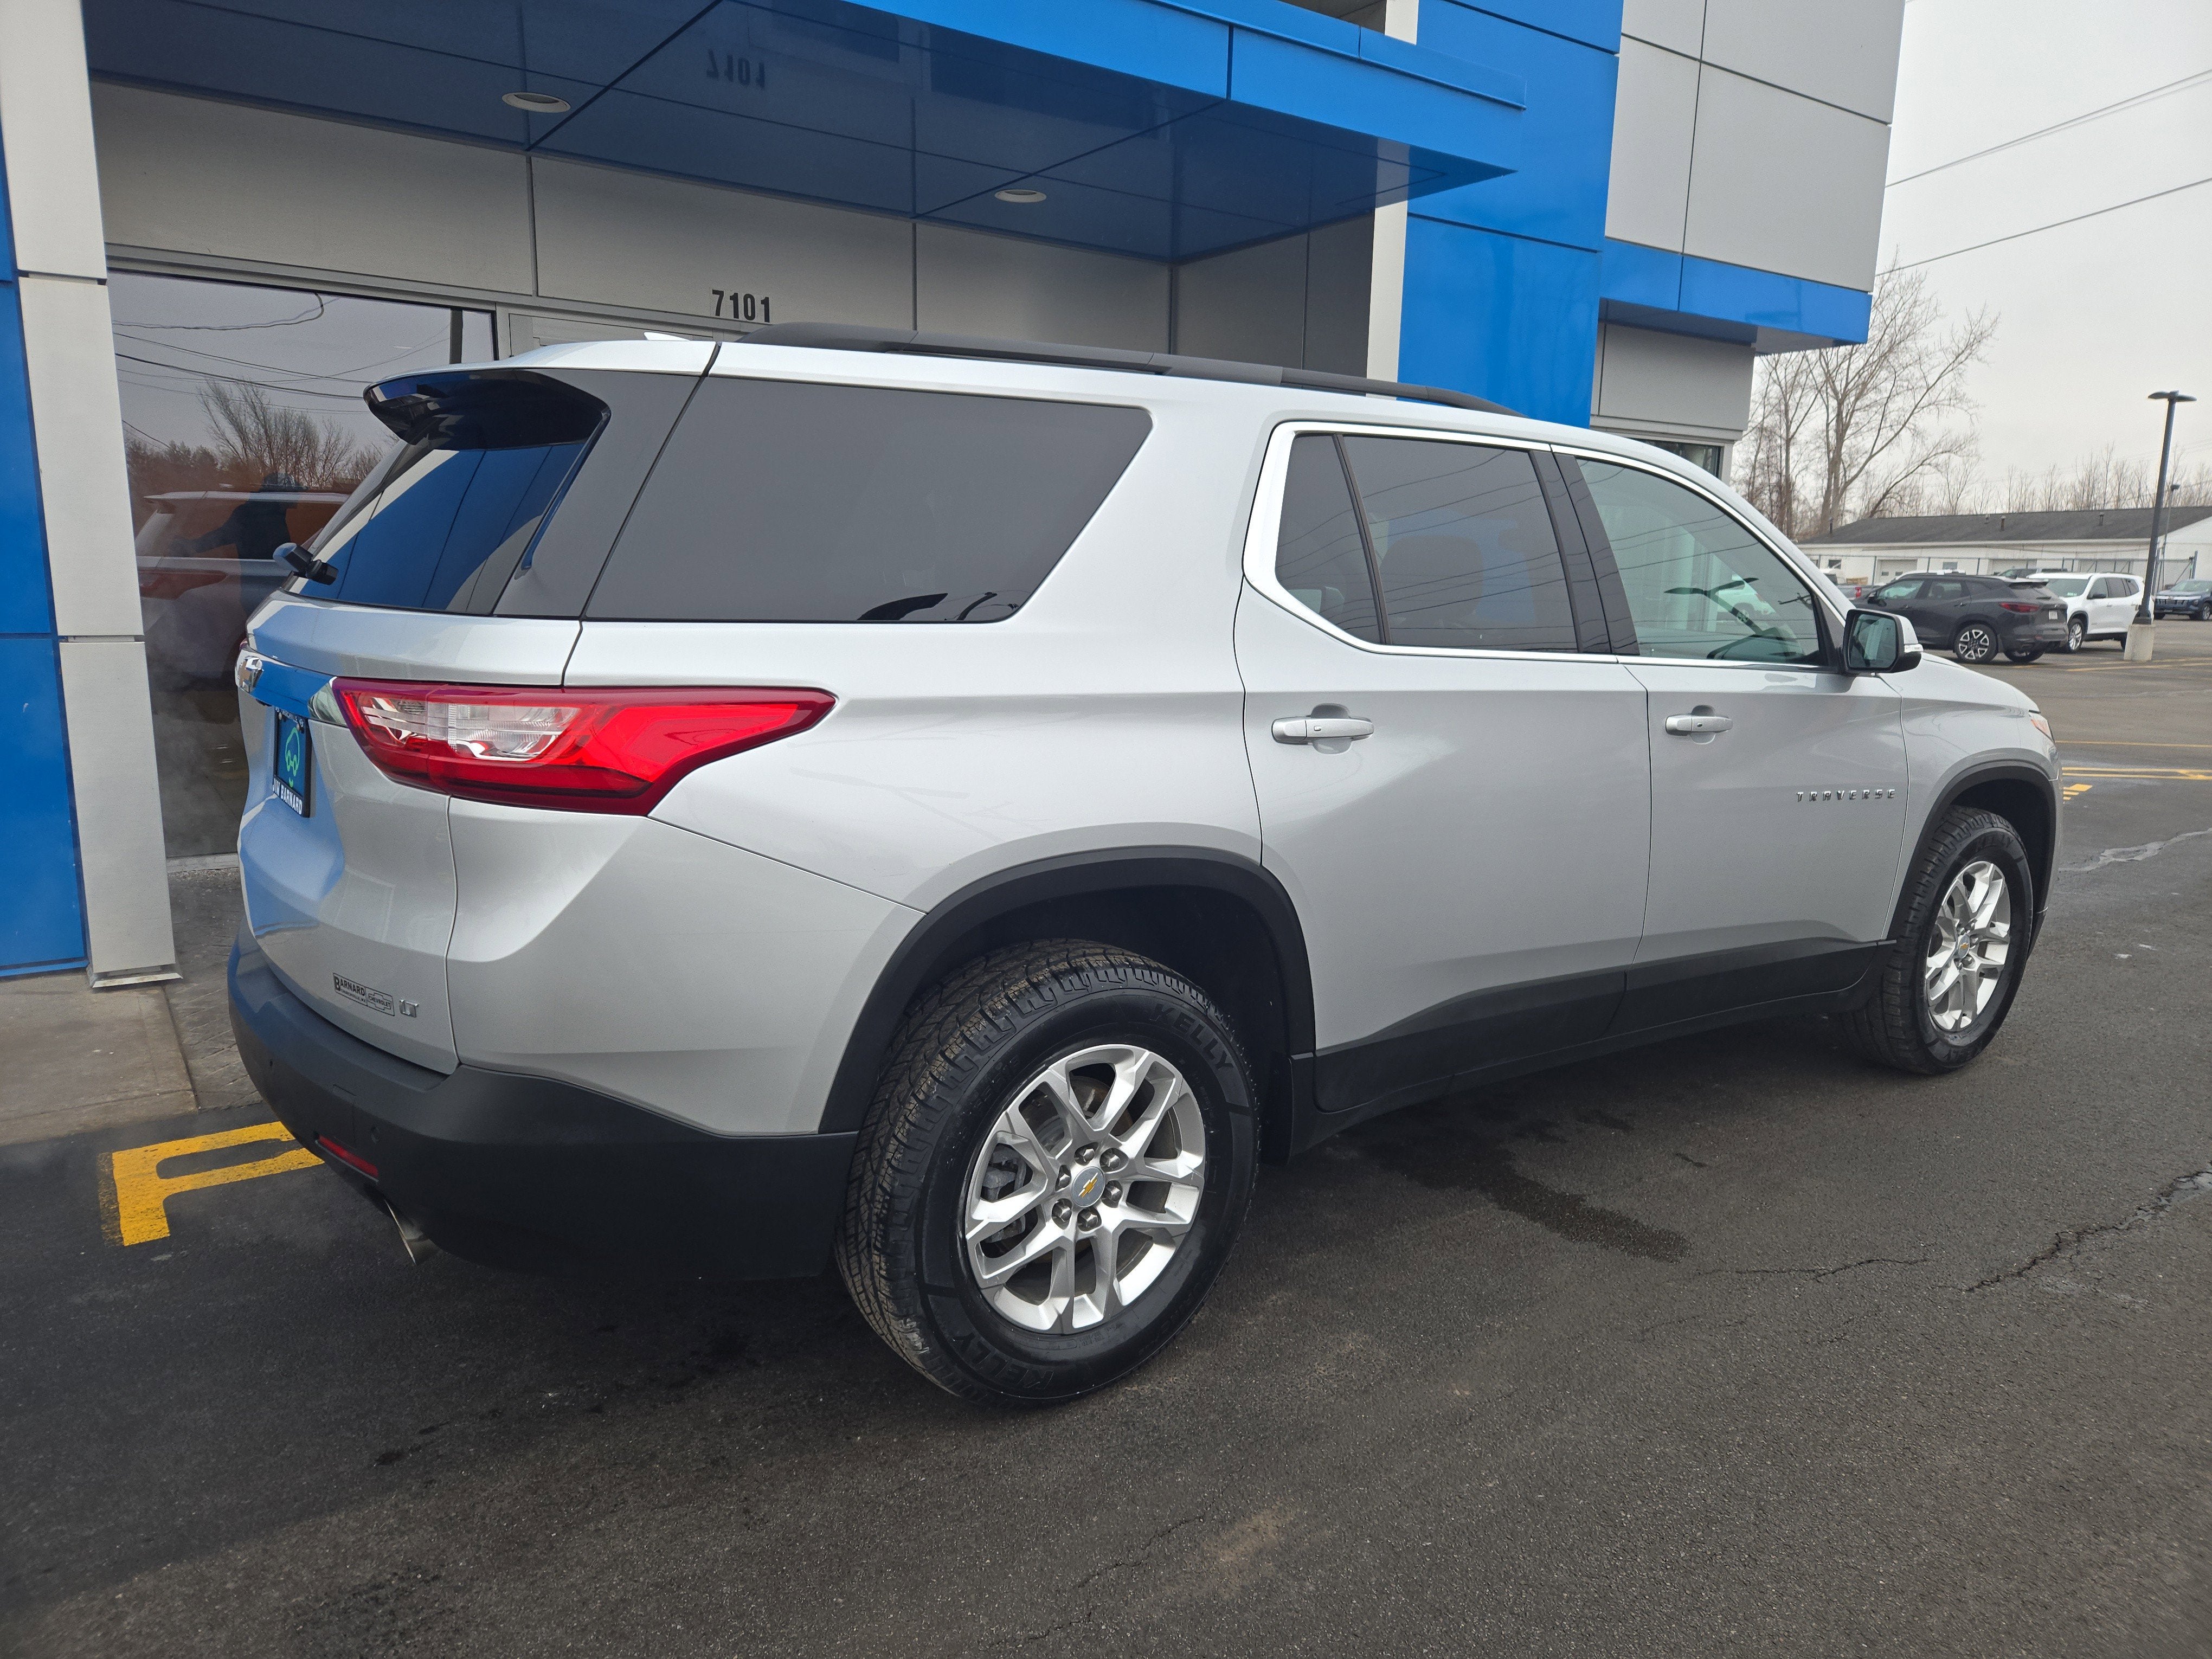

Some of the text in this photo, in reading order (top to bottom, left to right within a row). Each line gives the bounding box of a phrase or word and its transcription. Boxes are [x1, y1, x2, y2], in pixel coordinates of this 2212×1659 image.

[712, 289, 770, 323] 7101
[272, 778, 303, 815] JIM BARNARD
[1796, 789, 1895, 802] TRAVERSE
[333, 976, 365, 996] BARNARD
[1148, 1003, 1234, 1070] KELLY
